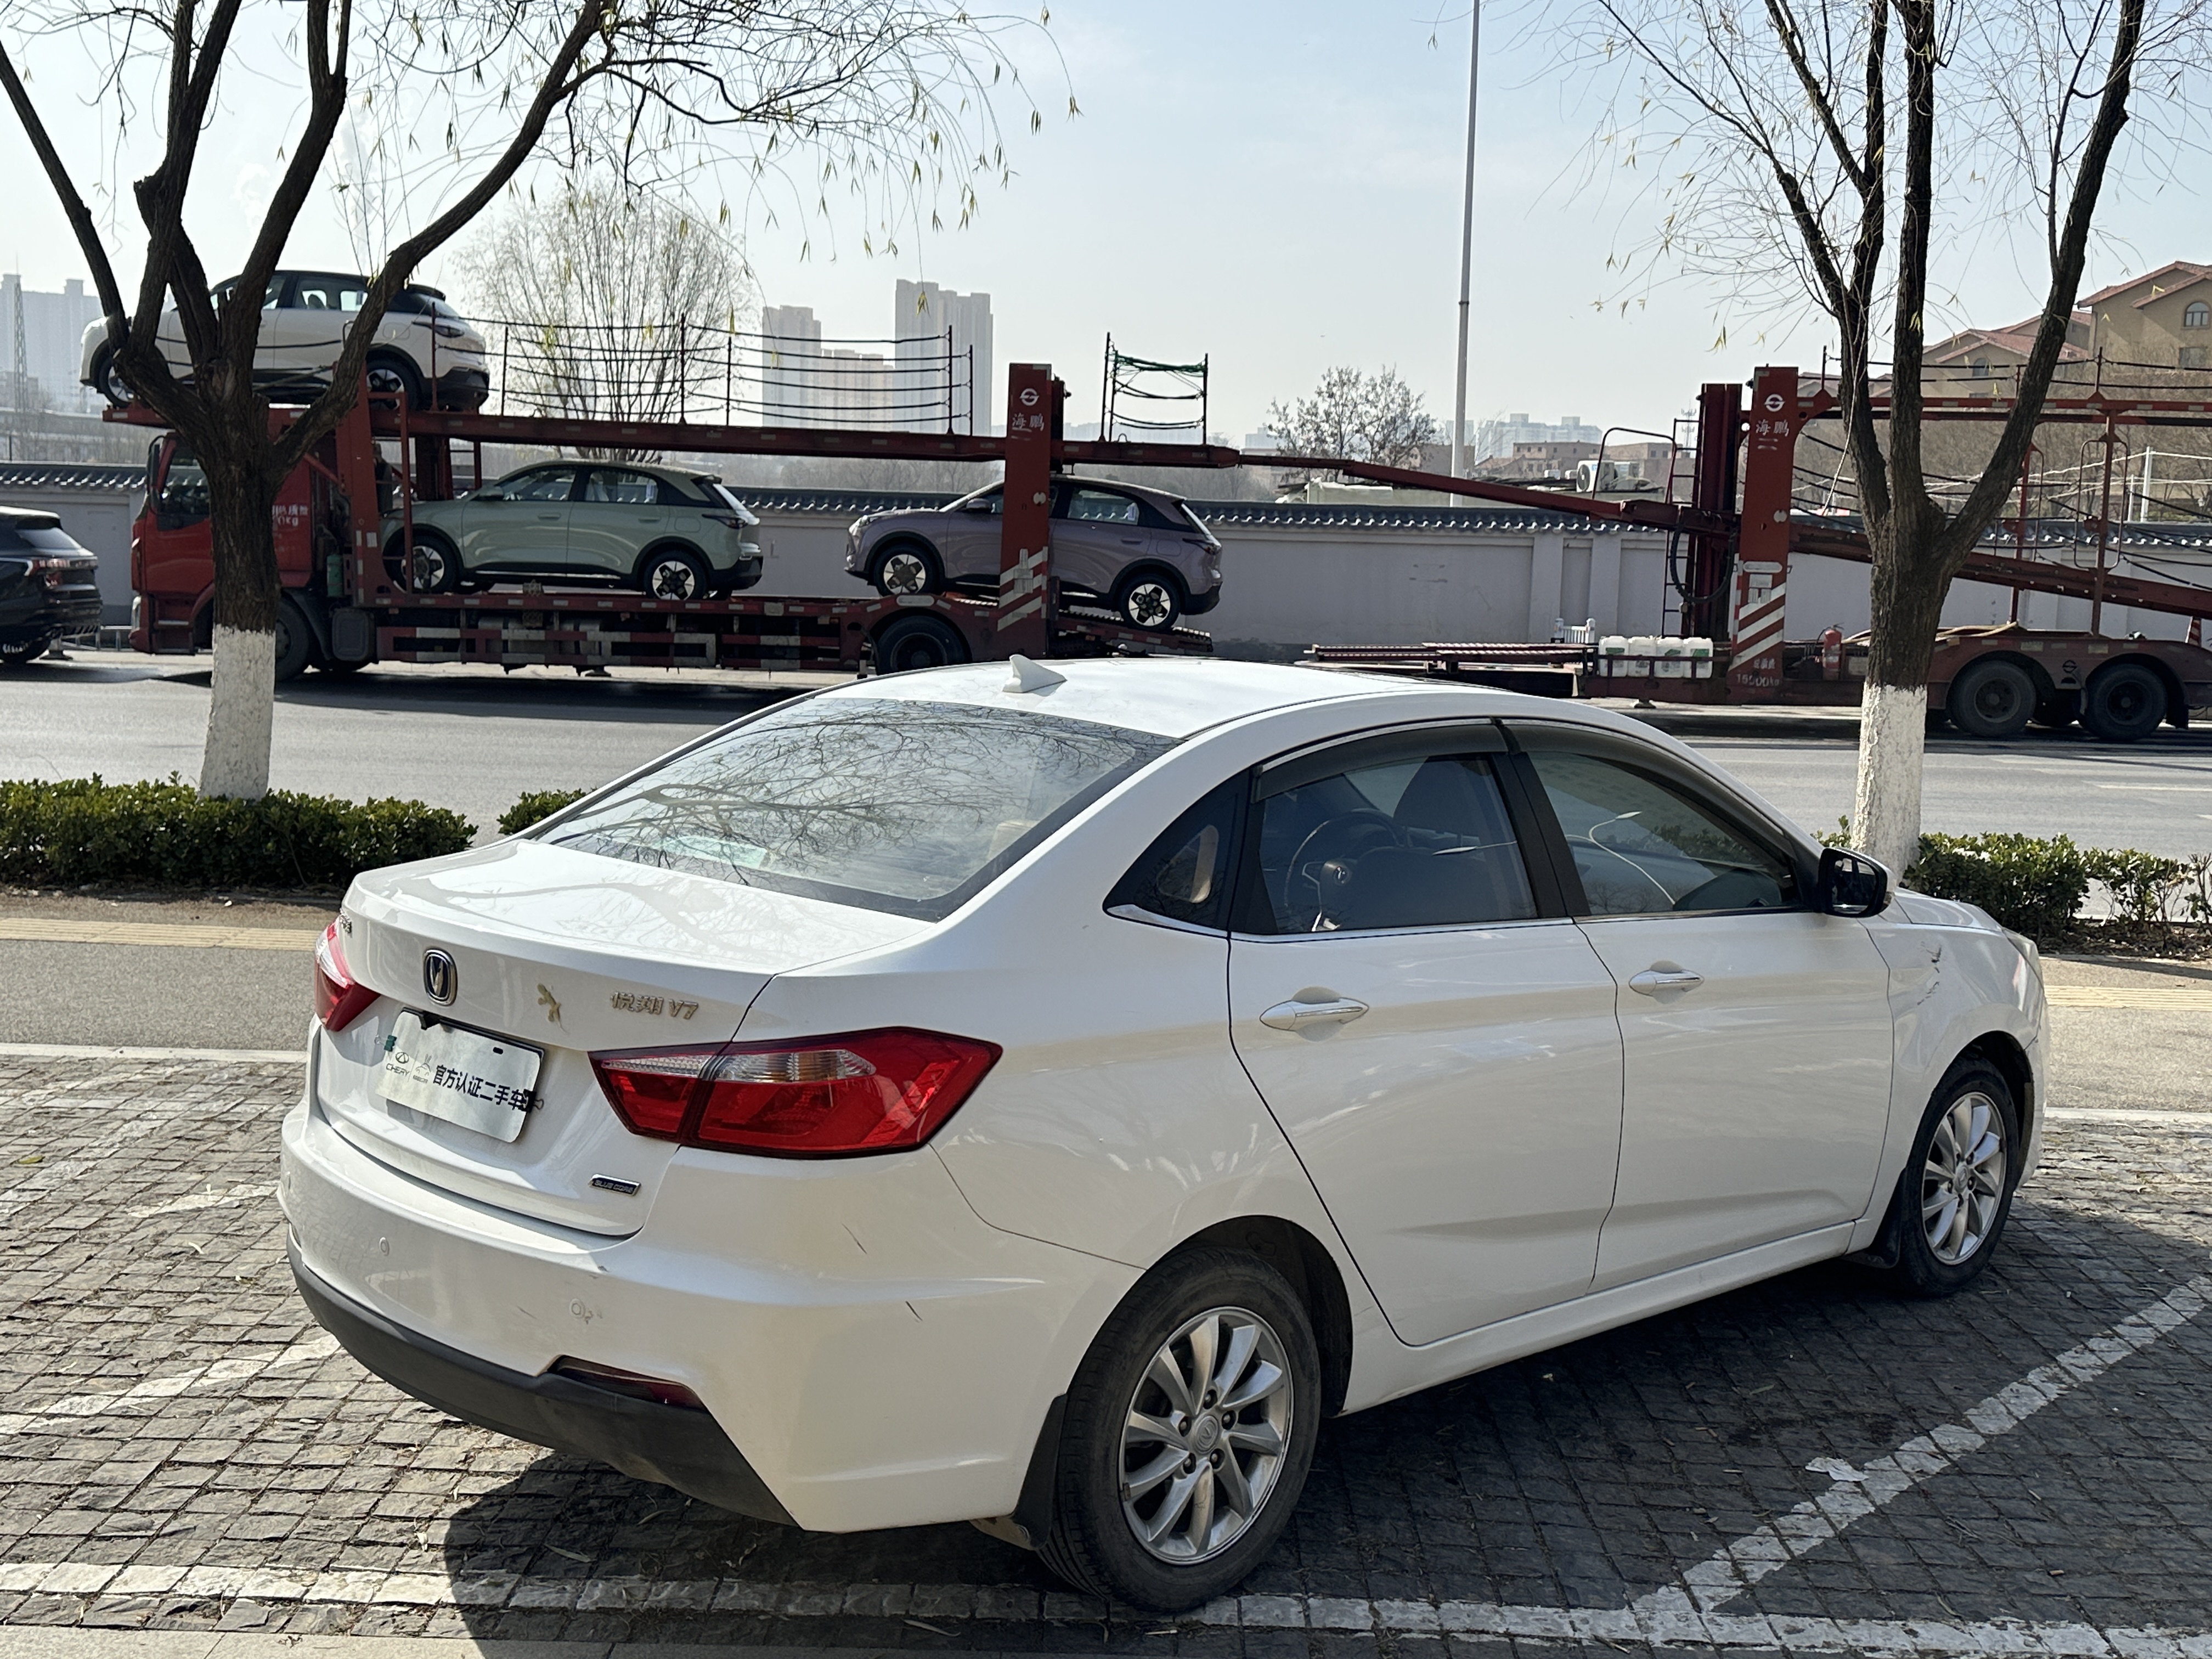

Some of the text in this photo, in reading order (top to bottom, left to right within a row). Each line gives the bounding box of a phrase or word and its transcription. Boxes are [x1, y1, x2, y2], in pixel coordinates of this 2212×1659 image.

[610, 991, 699, 1020] 悦翔 V7
[386, 1063, 410, 1076] CHERY
